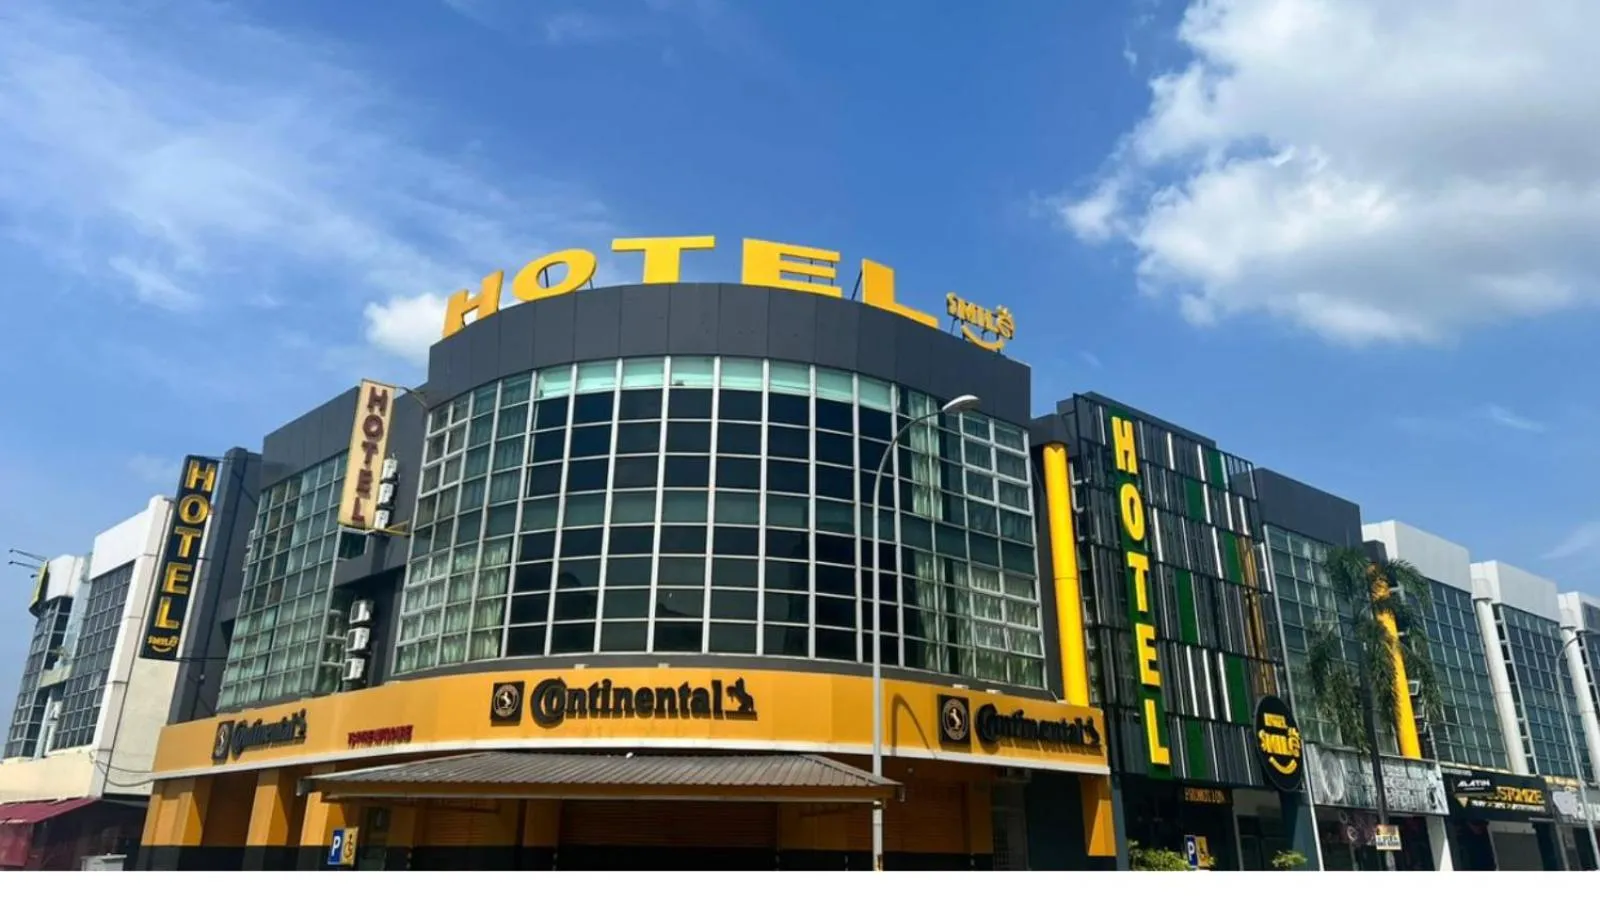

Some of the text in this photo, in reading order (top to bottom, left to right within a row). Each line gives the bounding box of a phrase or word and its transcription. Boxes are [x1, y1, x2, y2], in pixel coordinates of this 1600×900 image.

[443, 236, 938, 339] HOTEL
[352, 386, 388, 528] HOTEL
[155, 460, 216, 629] HOTEL
[1112, 416, 1170, 765] HOTEL
[530, 678, 724, 727] Continental
[331, 836, 341, 856] P
[1187, 841, 1195, 860] P
